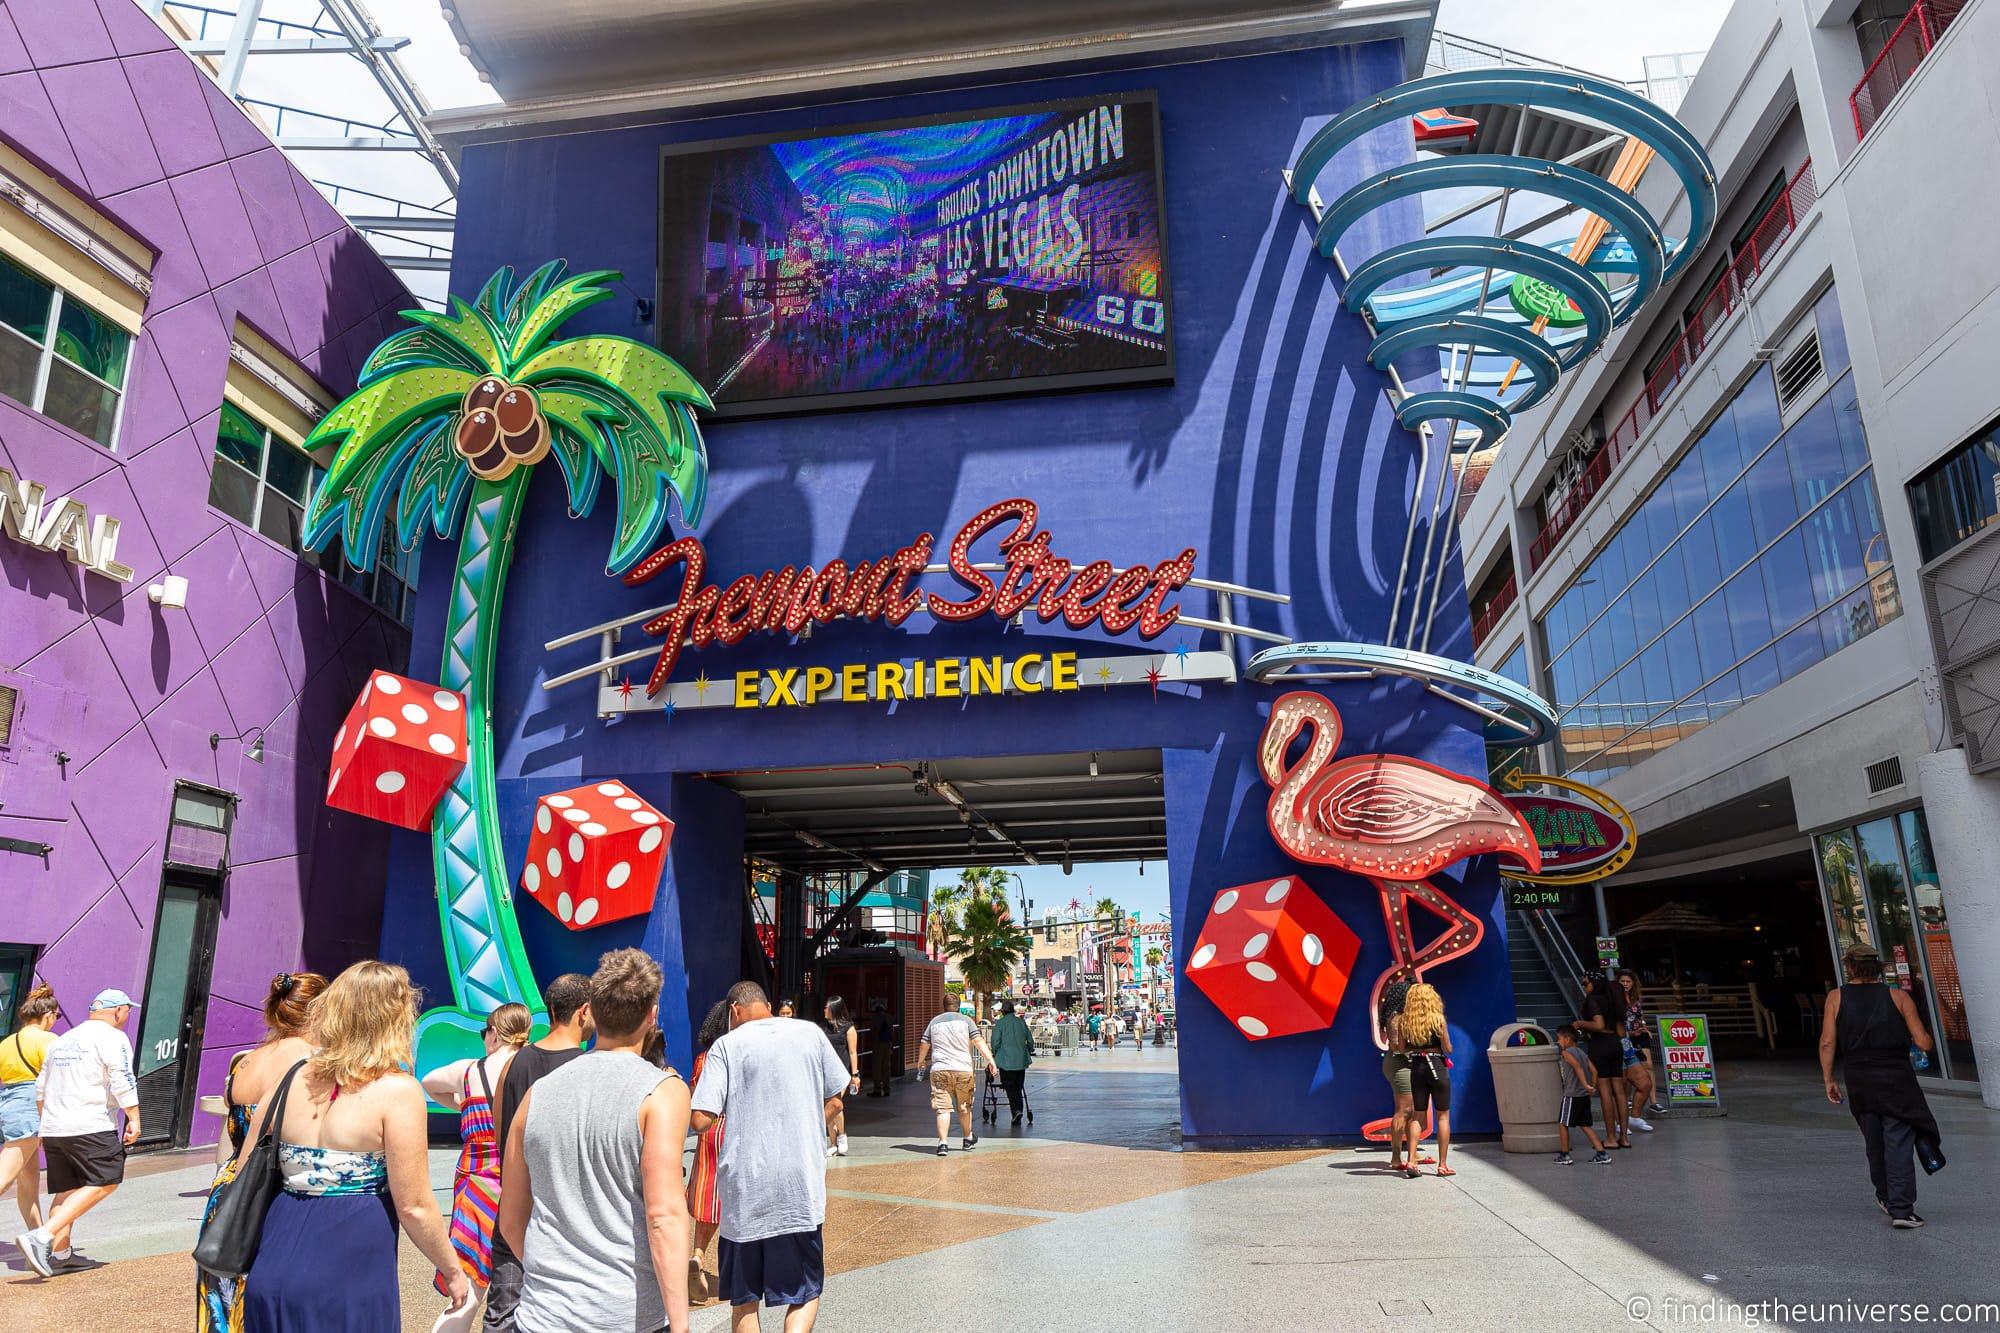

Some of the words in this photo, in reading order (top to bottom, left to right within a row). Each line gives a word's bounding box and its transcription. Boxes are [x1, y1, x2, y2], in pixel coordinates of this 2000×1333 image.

[937, 178, 980, 227] FABULOUS
[987, 104, 1125, 208] DOWNTOWN
[946, 219, 972, 269] LAS
[981, 184, 1084, 270] VEGAS
[622, 532, 935, 700] Fremont
[927, 497, 1199, 640] Street
[734, 651, 1081, 710] EXPERIENCE
[1513, 893, 1538, 904] 2:40
[1541, 892, 1559, 903] PM
[154, 1037, 179, 1061] 101
[1671, 1027, 1695, 1038] STOP
[1669, 1052, 1704, 1063] ONLY
